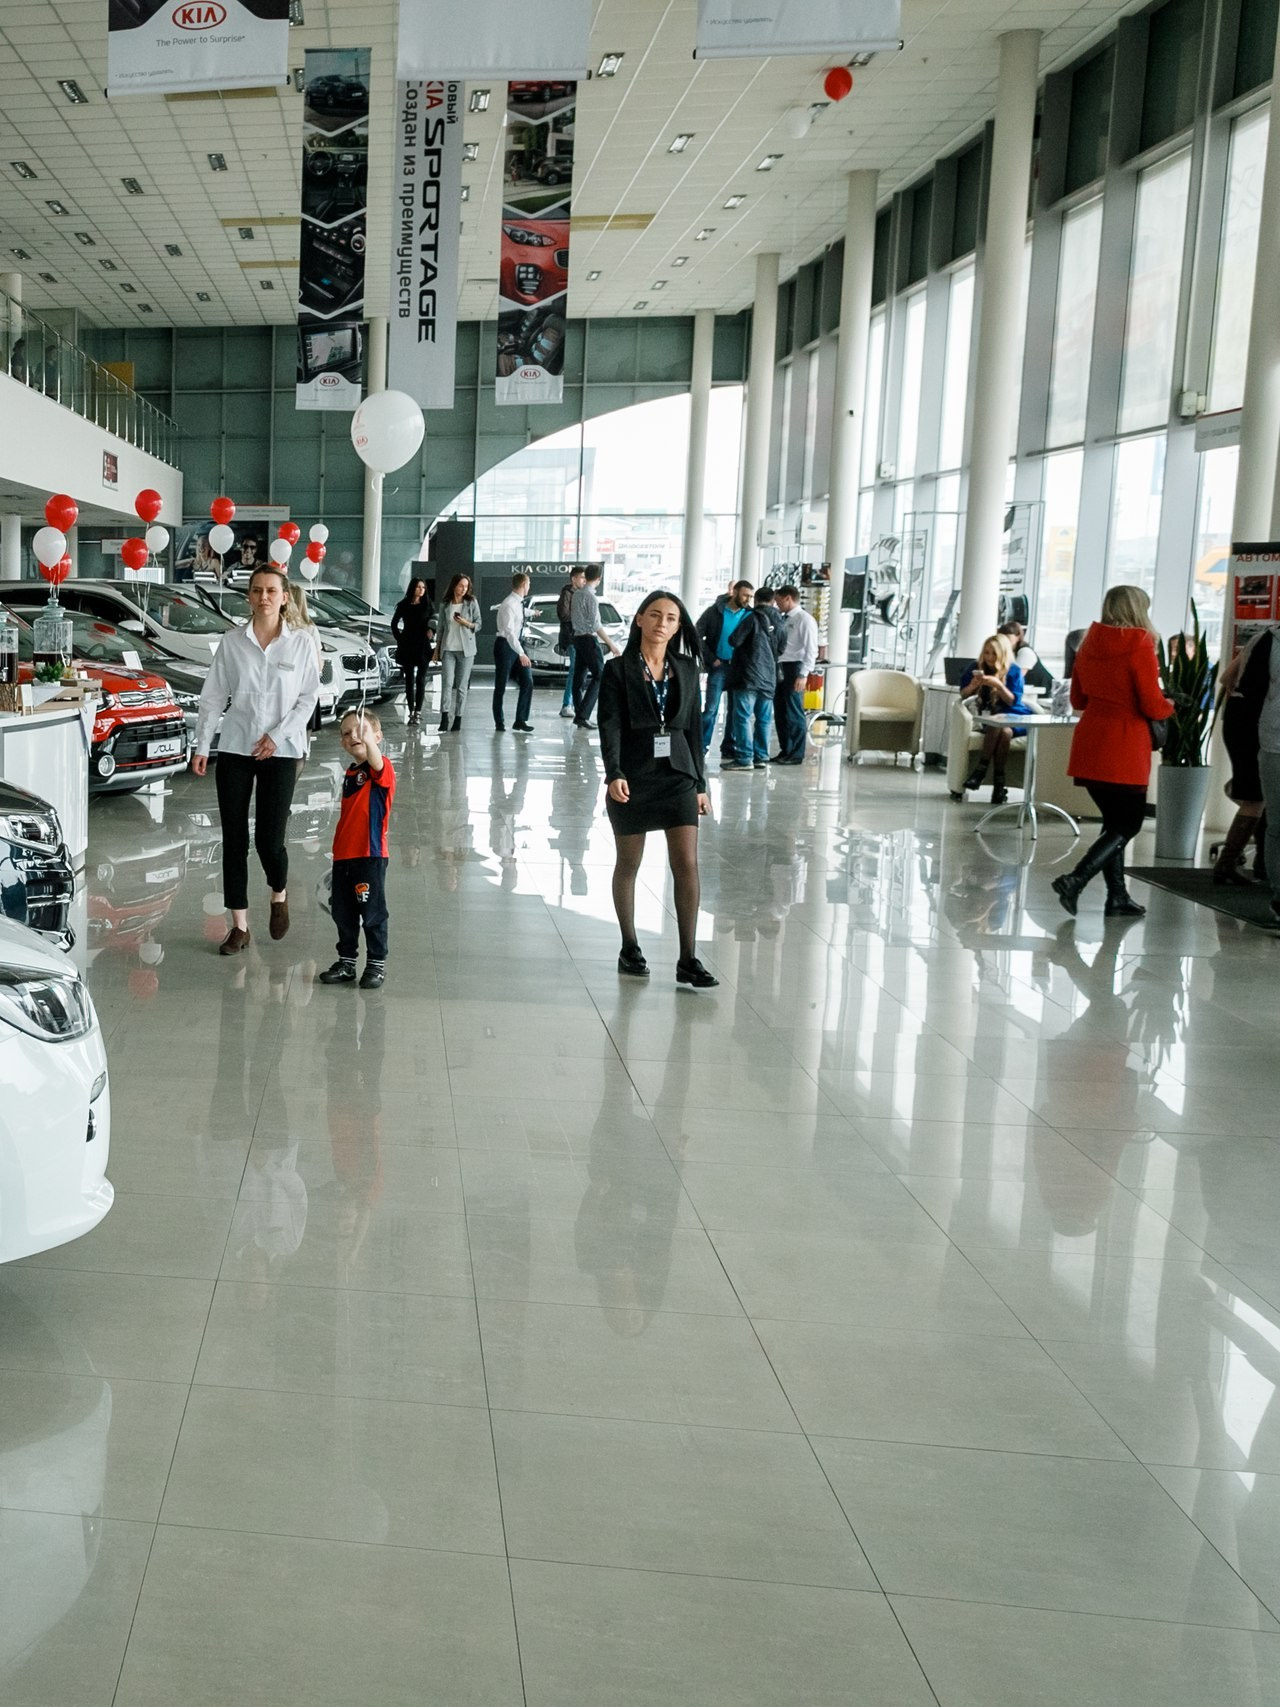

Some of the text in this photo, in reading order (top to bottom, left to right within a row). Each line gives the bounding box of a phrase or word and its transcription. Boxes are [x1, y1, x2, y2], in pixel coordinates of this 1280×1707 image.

[182, 7, 217, 24] KIA
[156, 38, 171, 47] The
[172, 37, 197, 46] Power
[199, 36, 208, 44] to
[403, 154, 416, 176] из
[417, 117, 445, 344] SPORTAGE
[396, 183, 415, 319] преимуществ
[511, 565, 581, 574] KIA QUO
